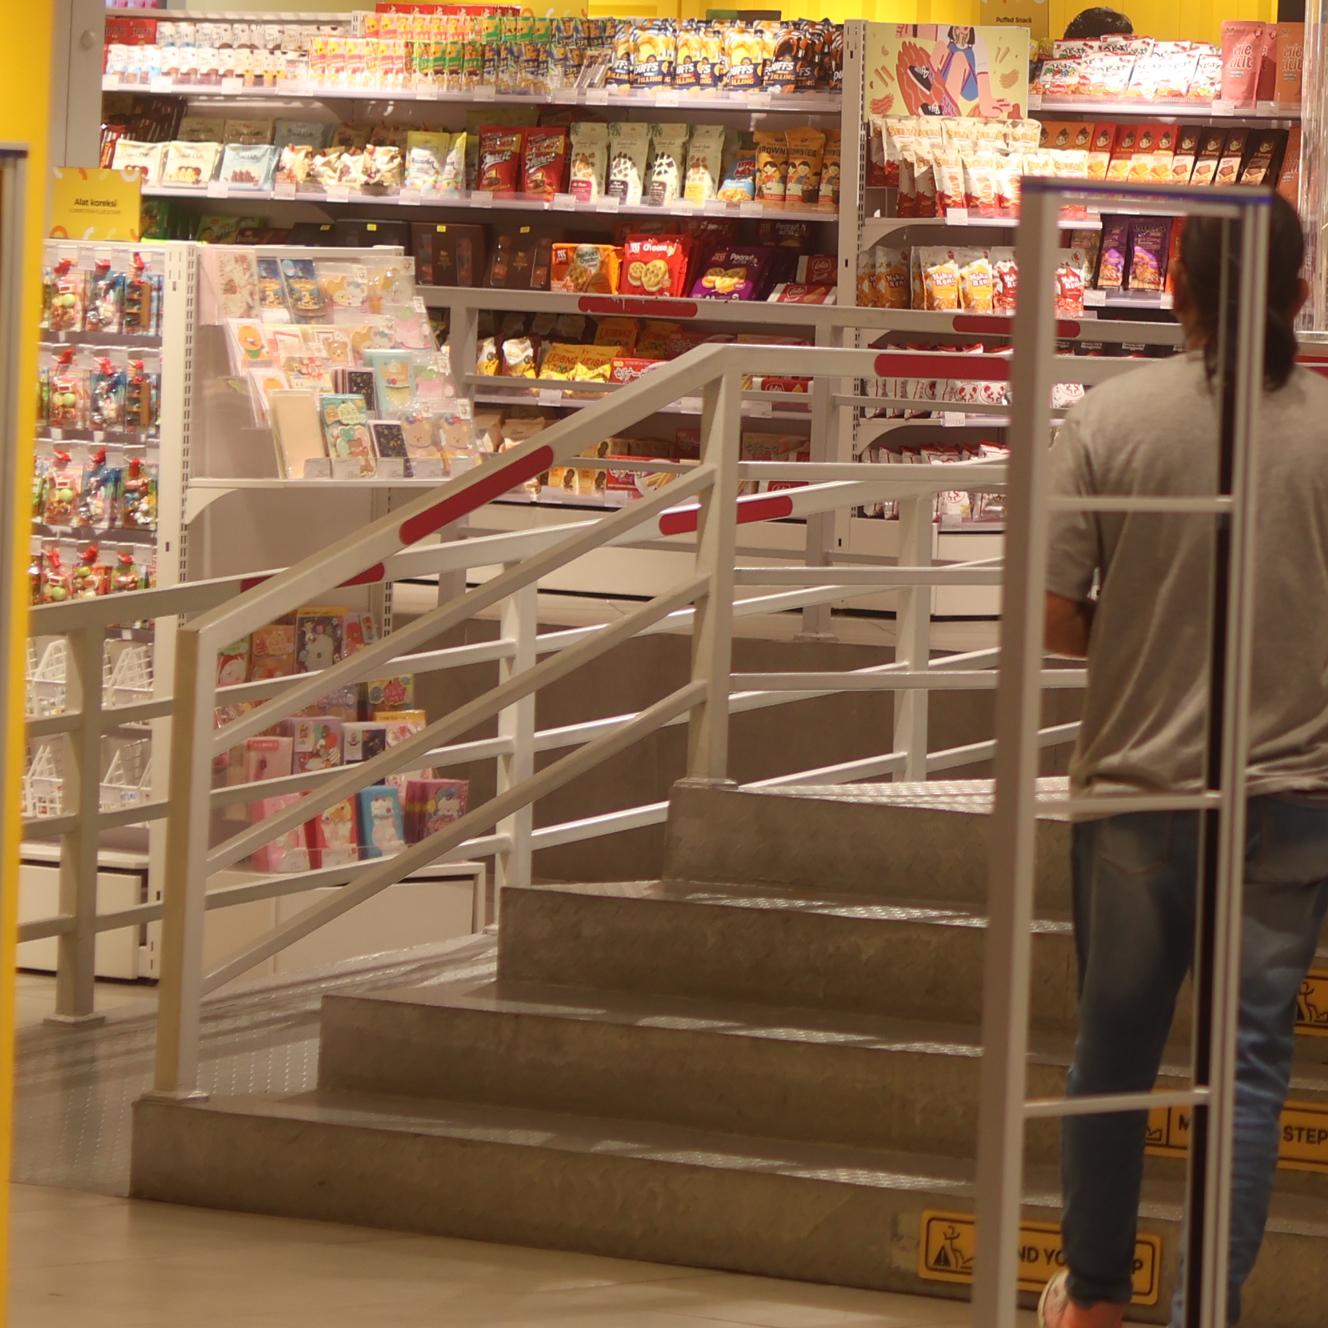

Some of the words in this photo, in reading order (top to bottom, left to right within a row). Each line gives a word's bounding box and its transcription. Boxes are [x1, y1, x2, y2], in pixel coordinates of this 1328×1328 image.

[74, 198, 89, 206] Alat
[90, 198, 118, 208] koreksi
[1282, 1125, 1328, 1146] STEP
[1018, 1245, 1040, 1264] ND
